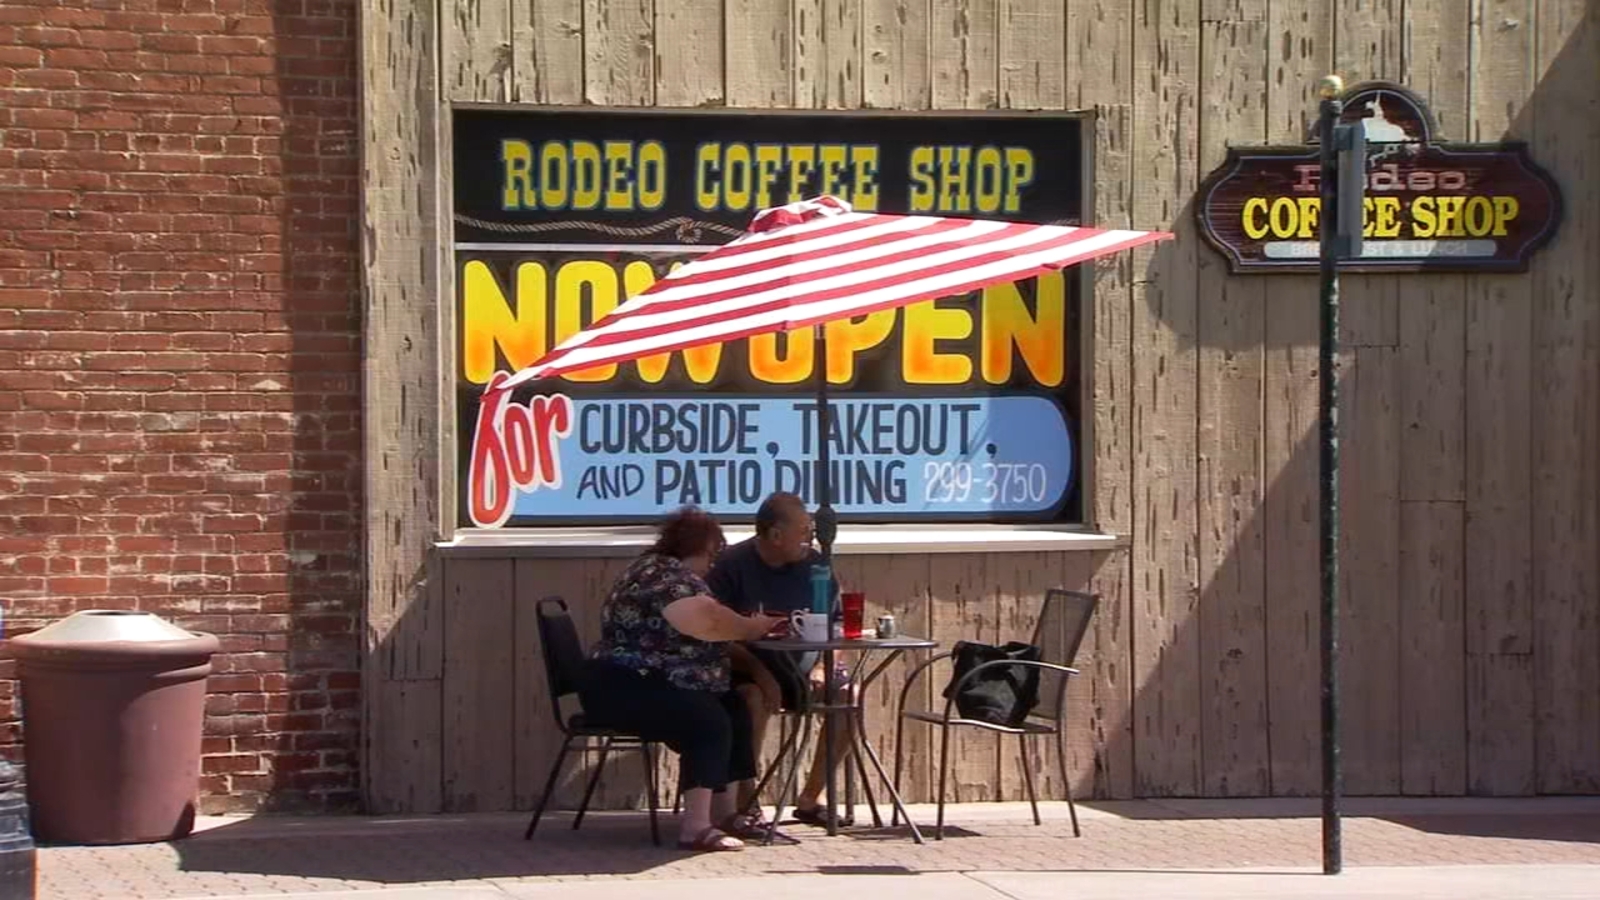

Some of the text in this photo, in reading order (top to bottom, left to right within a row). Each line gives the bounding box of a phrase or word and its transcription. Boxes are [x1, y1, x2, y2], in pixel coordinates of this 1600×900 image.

[502, 139, 1035, 213] RODEO COFFEE SHOP
[1293, 163, 1466, 191] Rdeo
[1242, 196, 1519, 239] COFE SHOP
[470, 372, 572, 527] for
[576, 459, 1046, 506] AND PATIO DINING 299-3750
